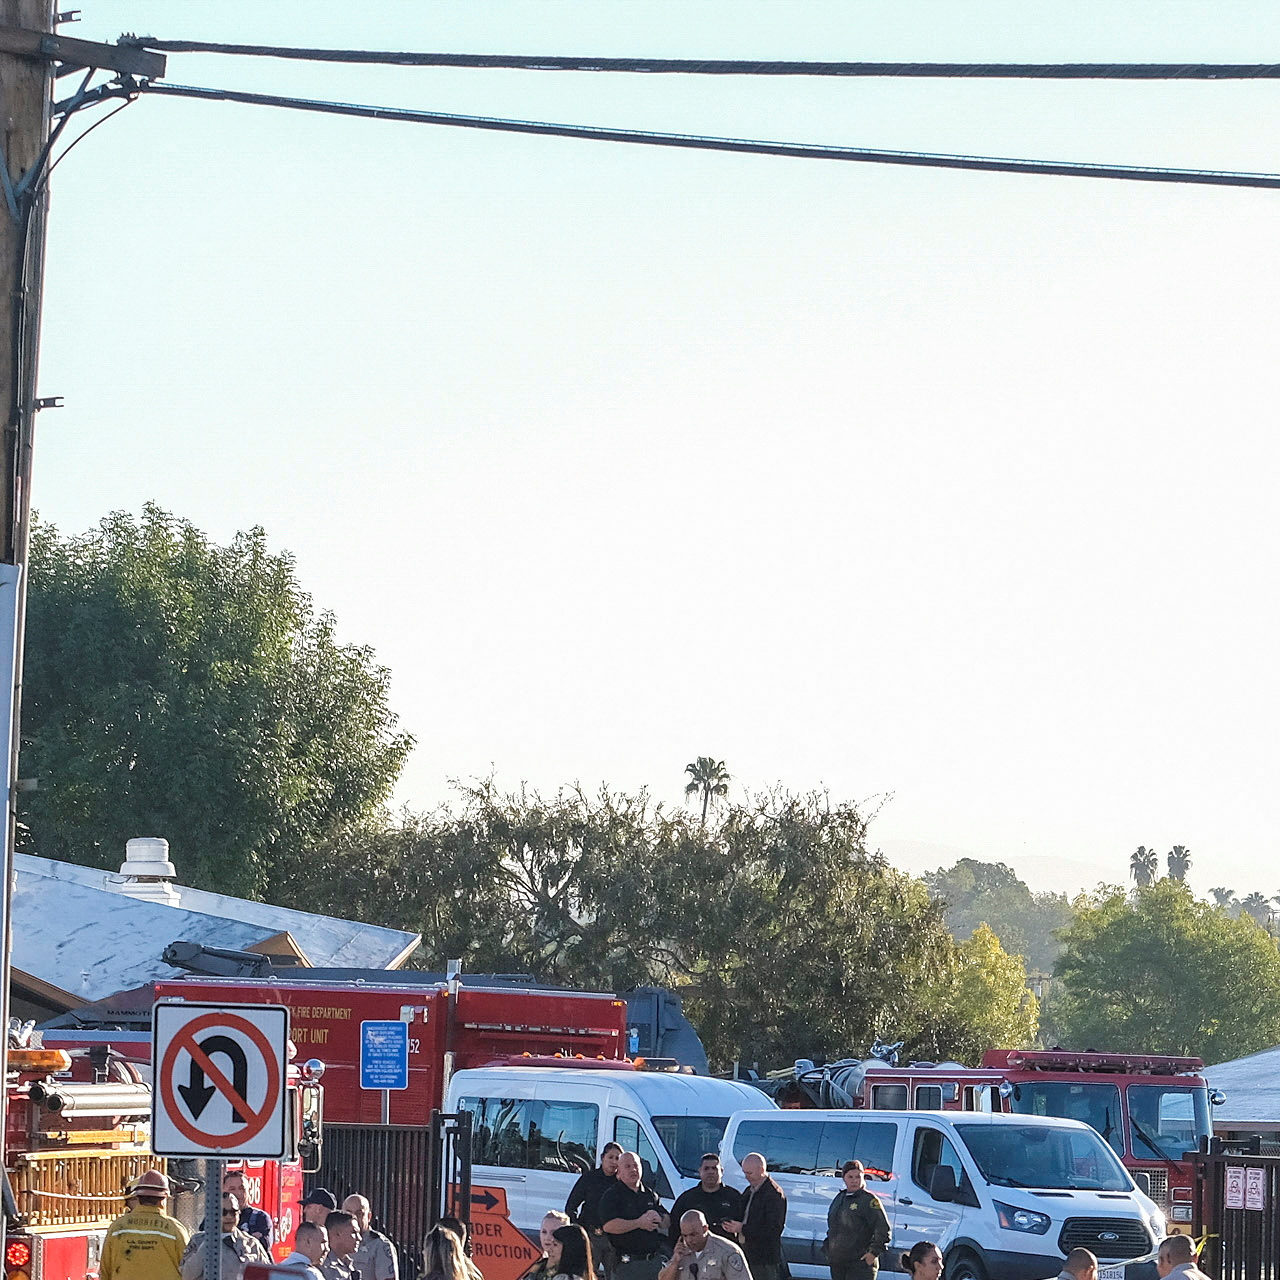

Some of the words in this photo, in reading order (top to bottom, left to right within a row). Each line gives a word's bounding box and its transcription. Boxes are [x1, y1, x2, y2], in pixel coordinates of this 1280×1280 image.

[298, 1006, 310, 1018] FIRE
[312, 1007, 352, 1020] DEPARTMENT
[310, 1028, 329, 1044] UNIT
[127, 1216, 171, 1231] MURRIETA
[473, 1243, 532, 1260] RUCTION
